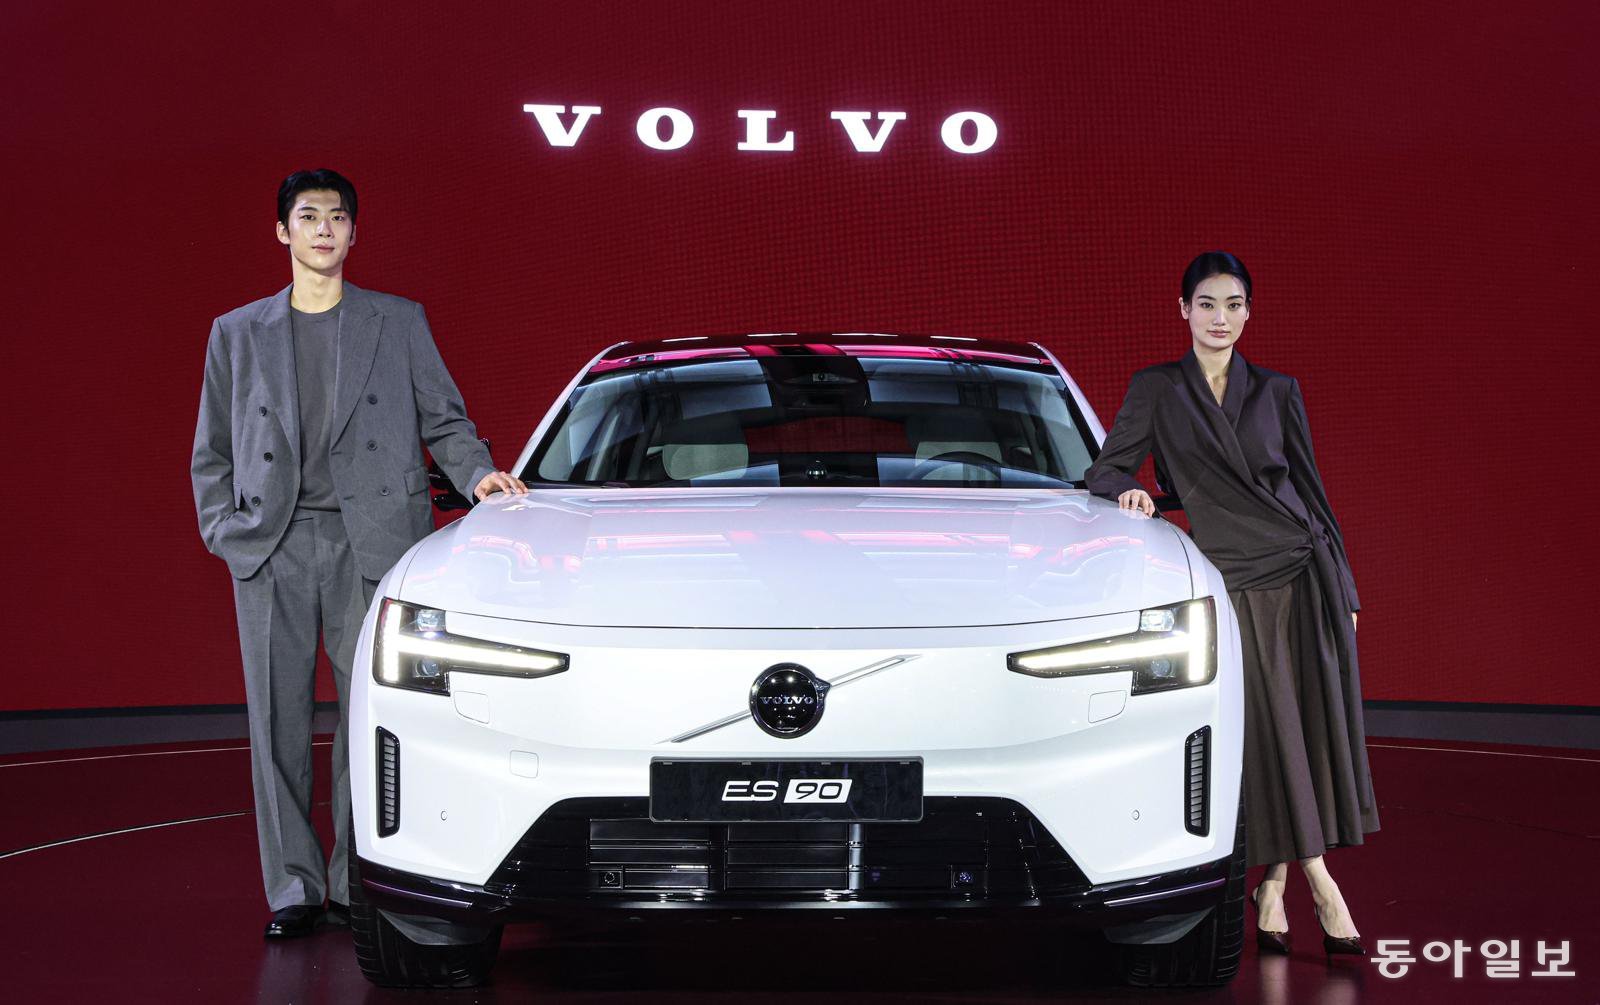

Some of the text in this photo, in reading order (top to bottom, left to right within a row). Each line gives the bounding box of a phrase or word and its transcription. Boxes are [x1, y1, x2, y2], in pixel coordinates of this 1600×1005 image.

[523, 103, 998, 154] VOLVO
[760, 696, 814, 705] VOLVO
[721, 780, 844, 802] ES 90
